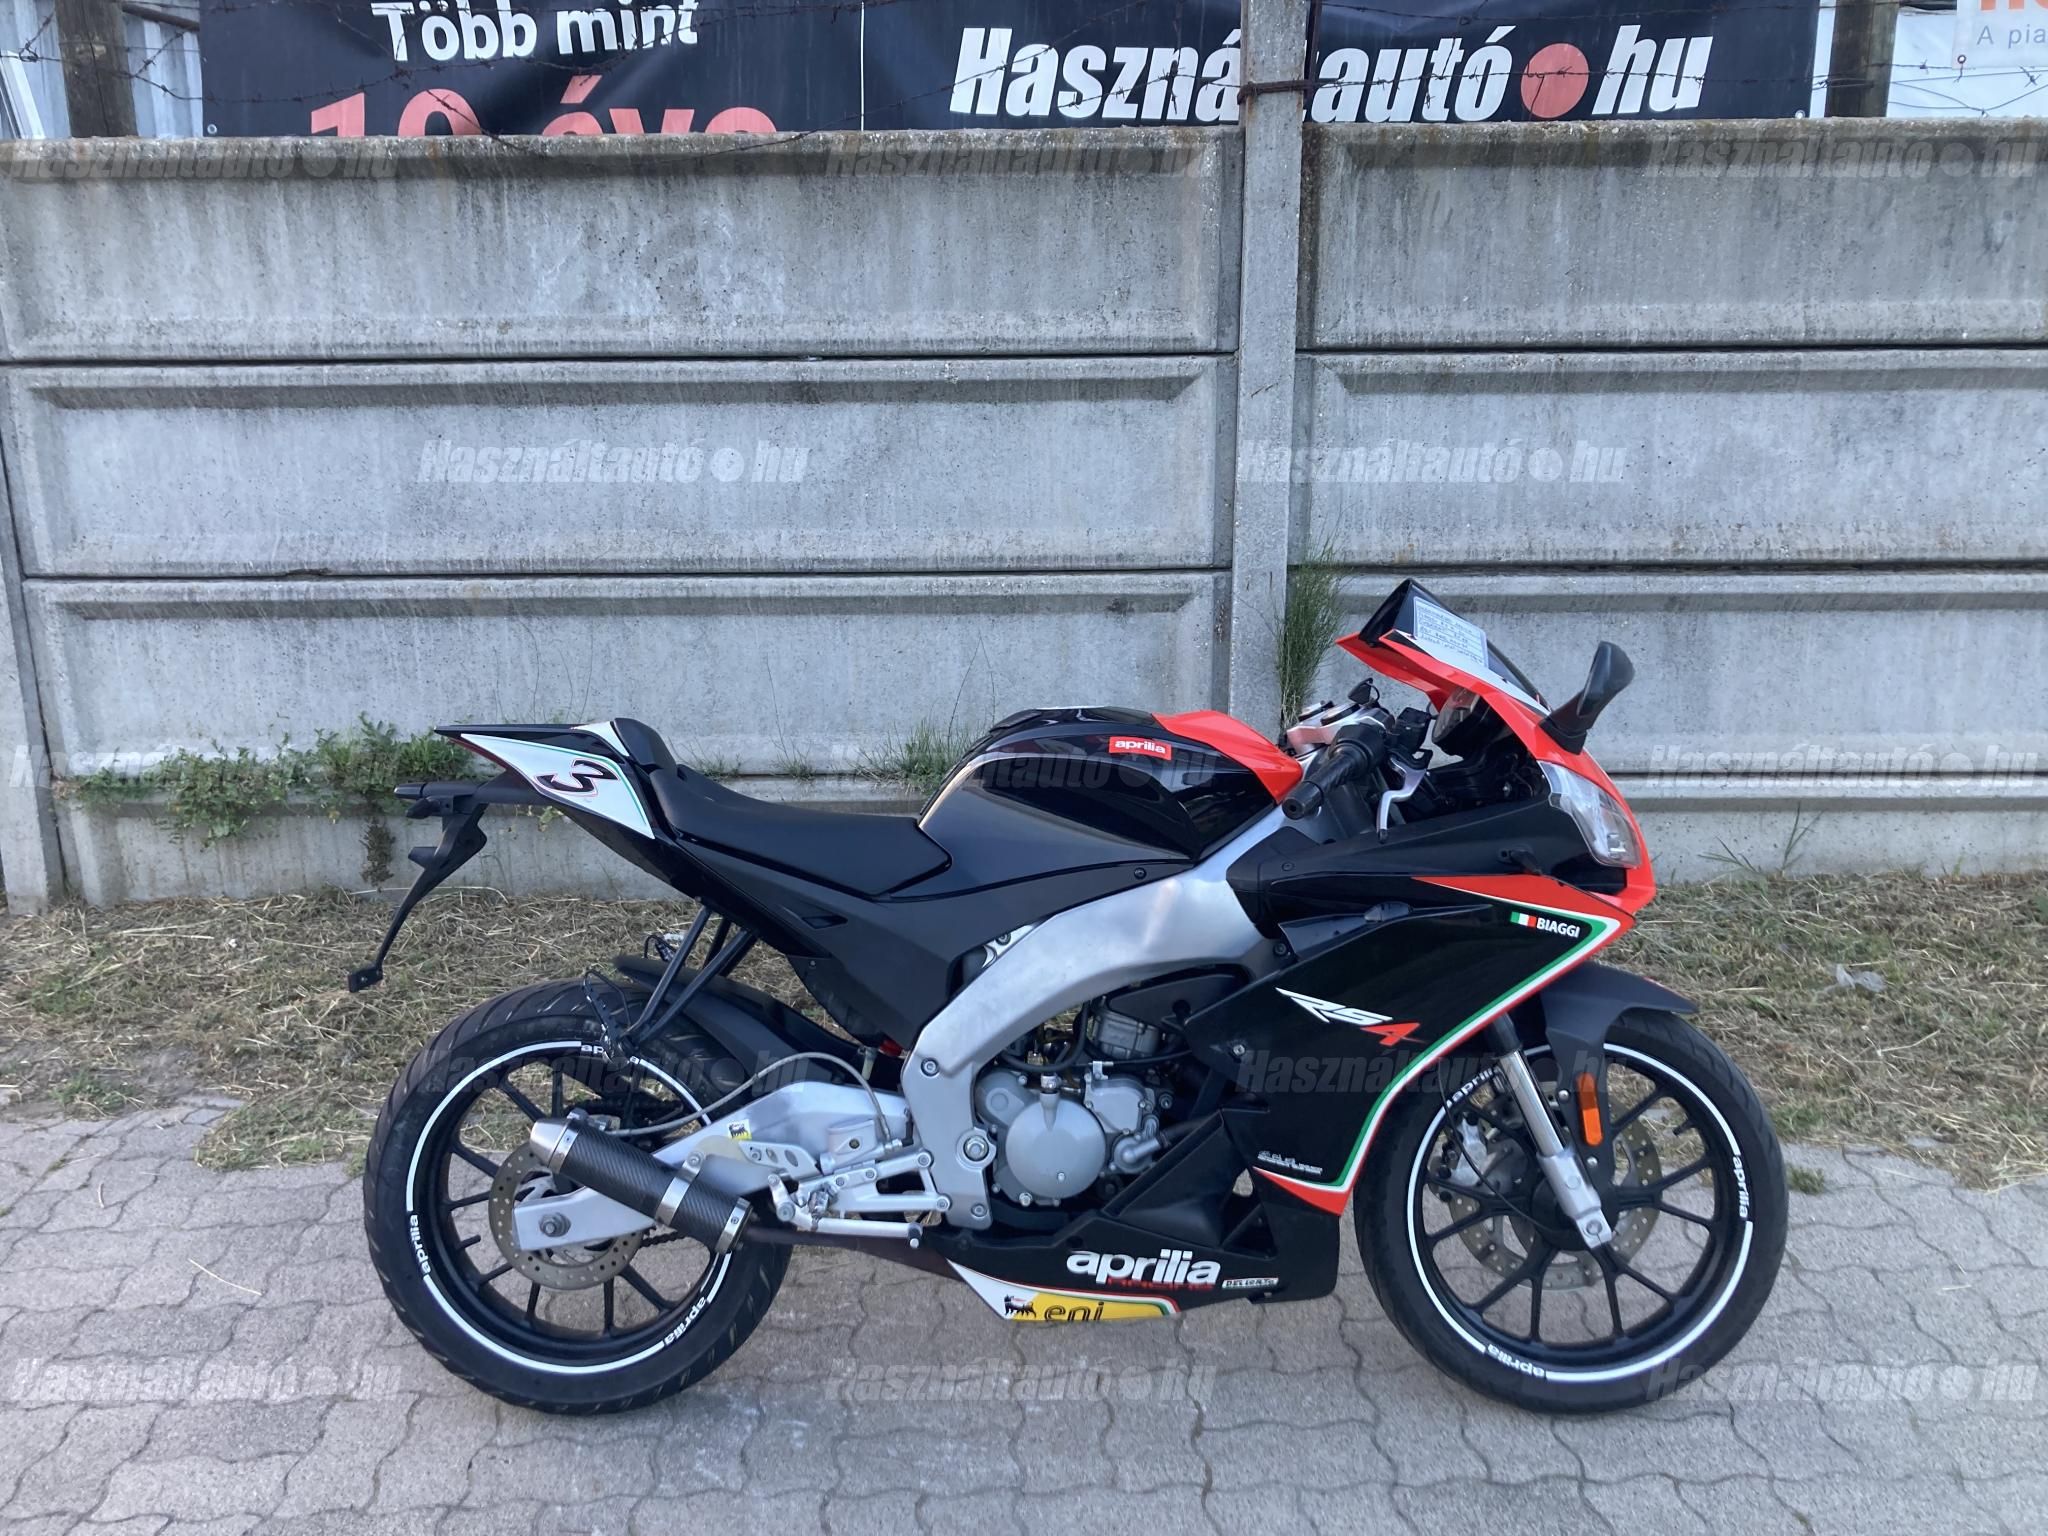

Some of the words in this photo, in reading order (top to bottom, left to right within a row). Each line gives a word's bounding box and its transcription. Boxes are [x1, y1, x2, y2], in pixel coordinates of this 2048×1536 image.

[372, 0, 538, 61] Több
[556, 0, 698, 54] mint
[1976, 25, 1994, 46] A
[1114, 740, 1166, 755] aprilia
[1536, 916, 1581, 938] BIAGGI
[1732, 1156, 1750, 1218] aprilia
[409, 1214, 432, 1274] aprilia
[1066, 1248, 1222, 1285] aprilia
[664, 1296, 706, 1346] aprilia
[1487, 1343, 1546, 1378] aprilia
